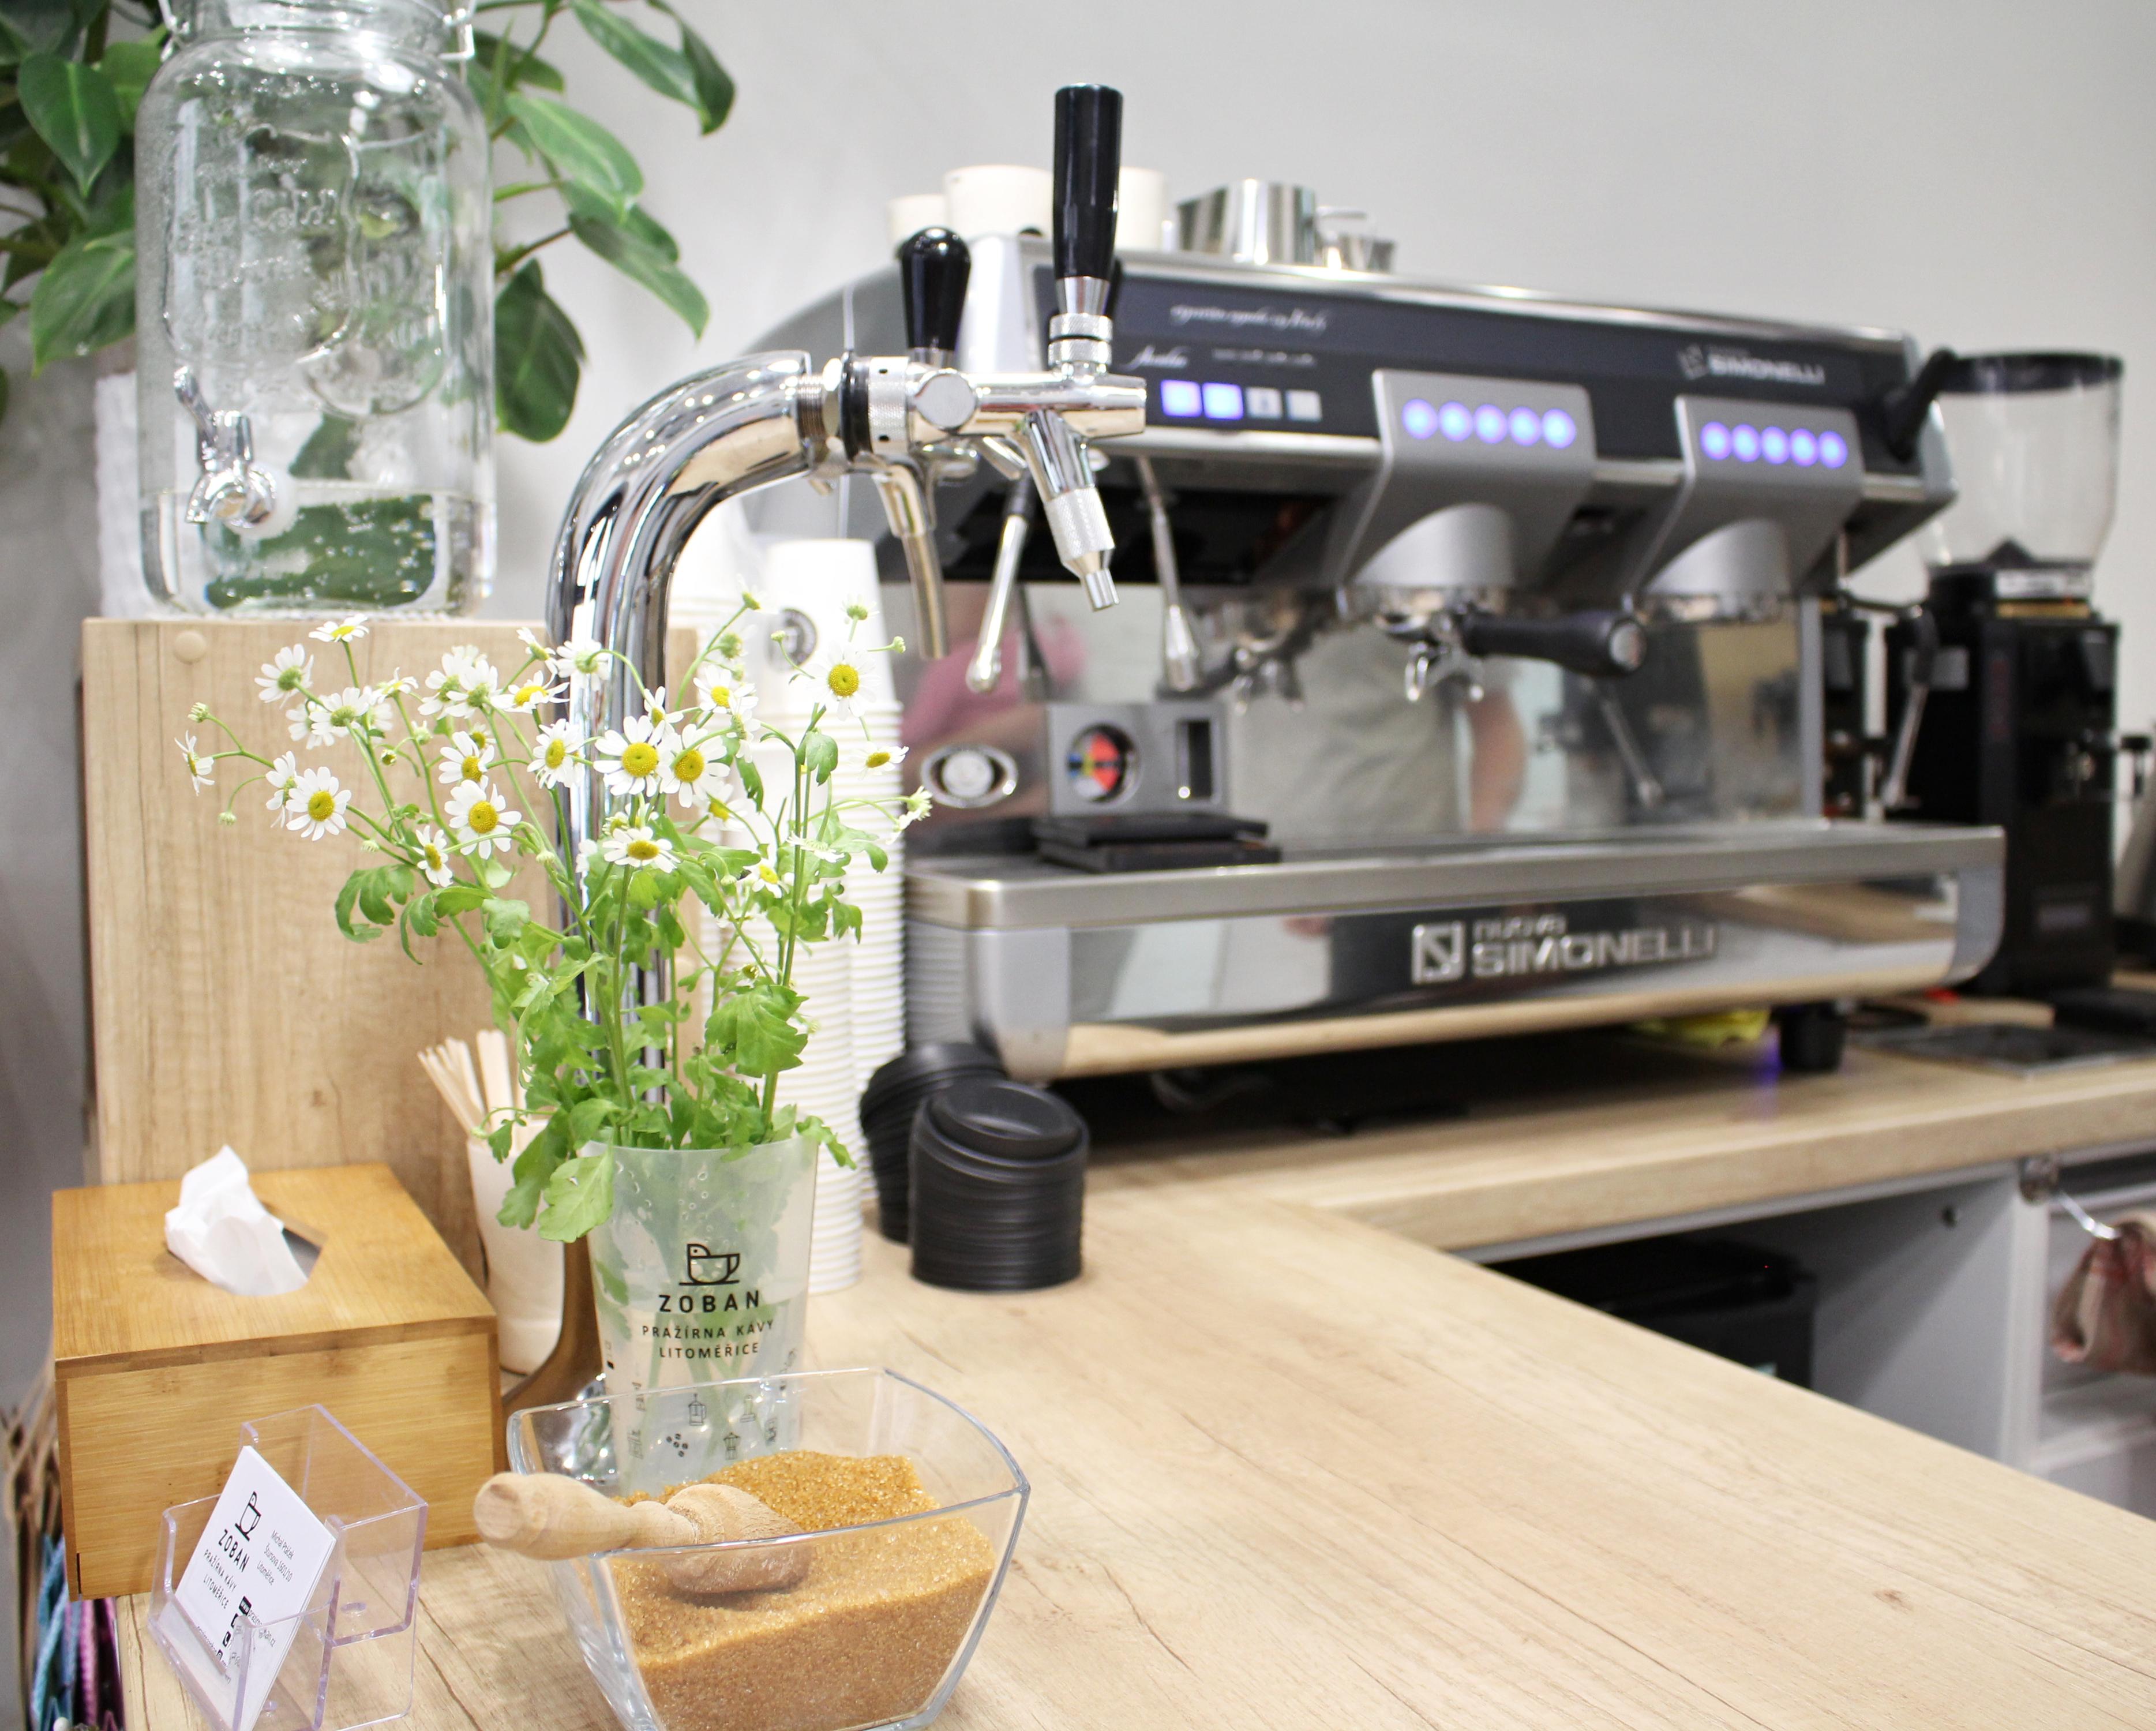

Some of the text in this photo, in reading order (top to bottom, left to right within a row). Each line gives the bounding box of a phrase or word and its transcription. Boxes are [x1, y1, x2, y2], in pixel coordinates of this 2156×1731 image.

[1472, 926, 1715, 978] SIMONELLI
[659, 1290, 759, 1313] ZOBAN
[642, 1325, 726, 1339] PRAŽÍRNA
[218, 1528, 250, 1573] ZOBAN
[224, 1575, 237, 1593] KÁVY
